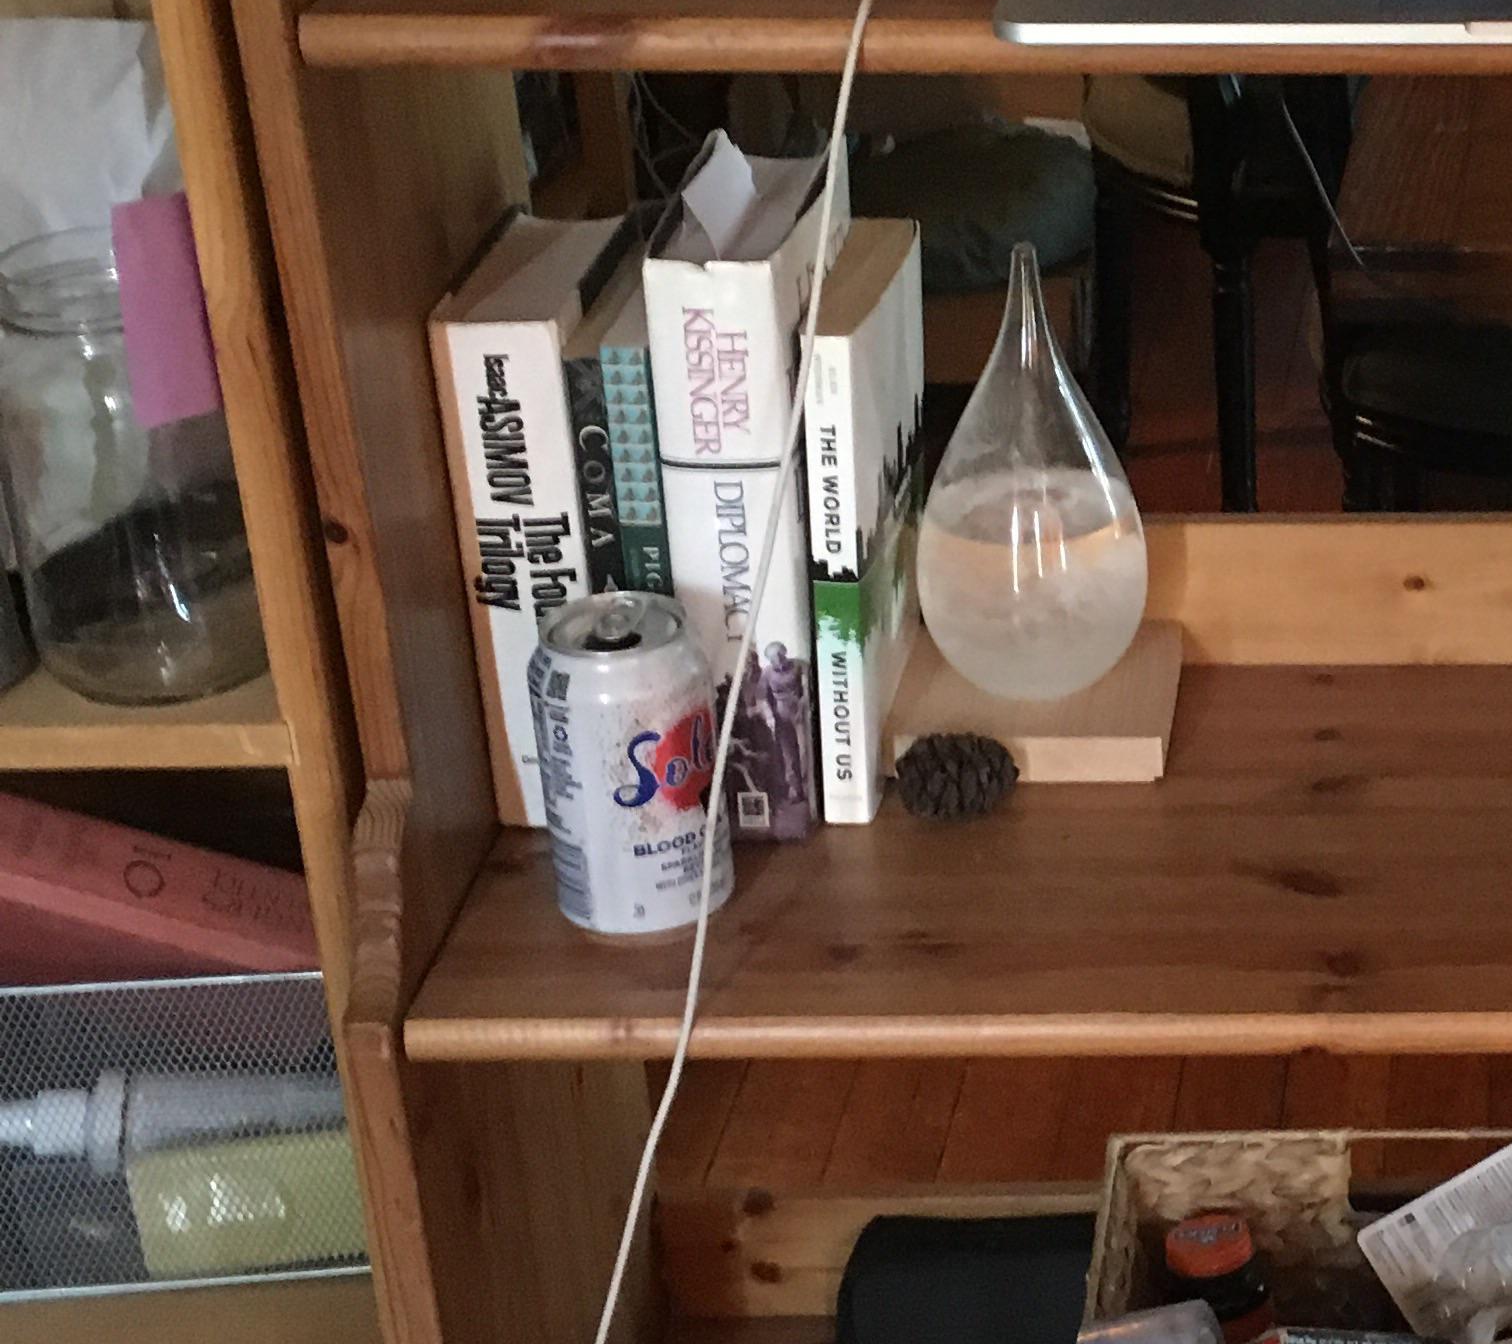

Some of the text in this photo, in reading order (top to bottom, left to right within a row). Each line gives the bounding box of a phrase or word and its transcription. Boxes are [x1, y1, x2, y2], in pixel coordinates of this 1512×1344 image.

[682, 306, 722, 456] KISSINGER
[717, 330, 750, 435] HENRY
[476, 395, 534, 507] ASIMOV
[578, 424, 616, 549] COMA
[819, 424, 838, 468] THE
[474, 513, 525, 611] Trilogy
[523, 511, 571, 564] The
[821, 475, 842, 554] WORLD
[831, 651, 853, 781] WITHOUT US
[632, 830, 697, 857] BLOOD
